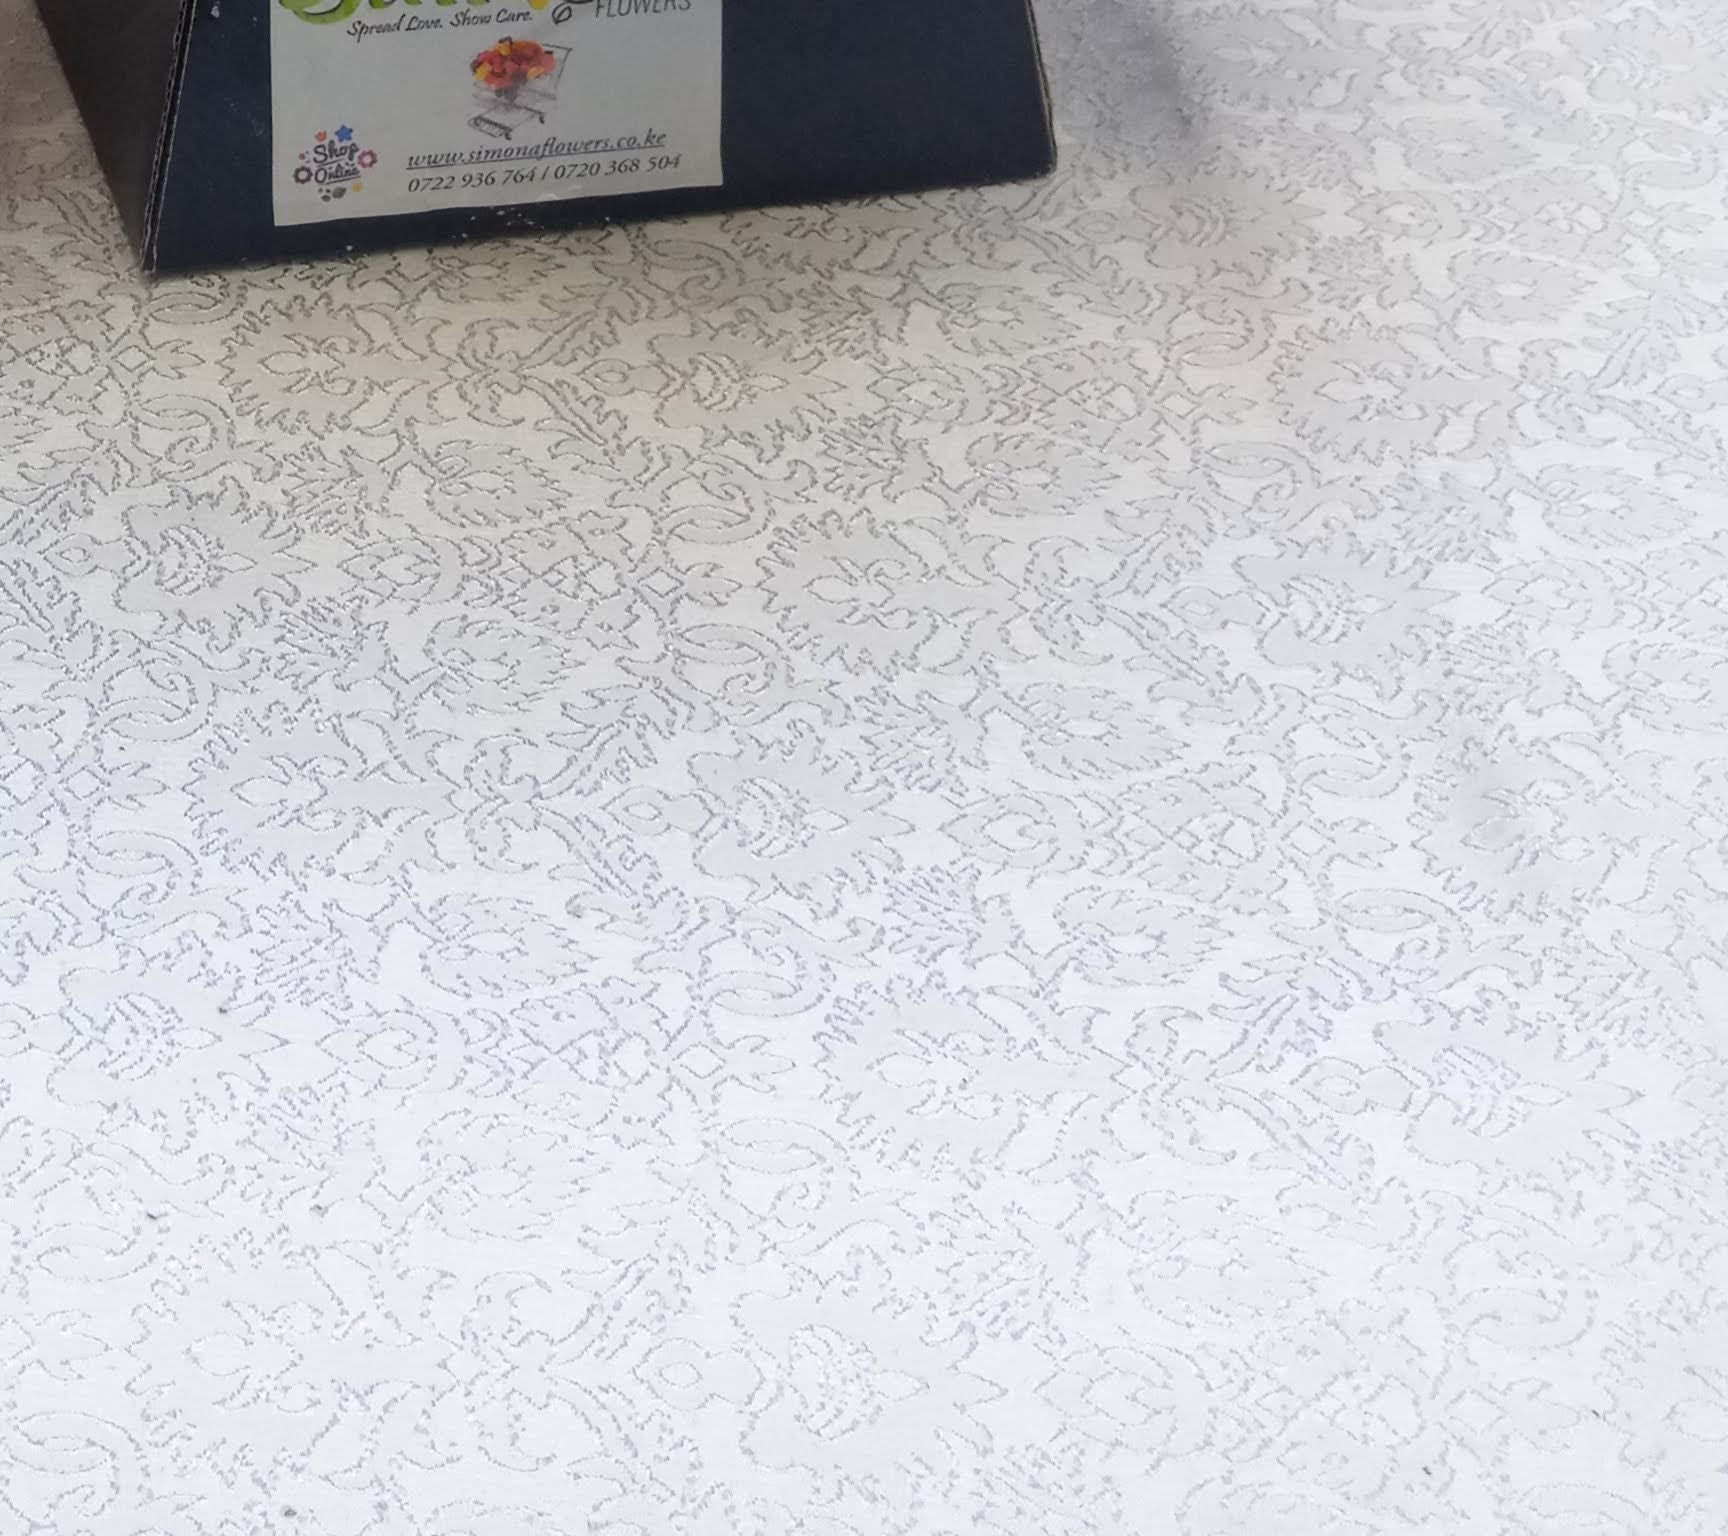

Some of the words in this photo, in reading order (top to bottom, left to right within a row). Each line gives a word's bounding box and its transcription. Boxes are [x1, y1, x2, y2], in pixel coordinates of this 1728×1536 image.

[346, 14, 405, 43] Spread
[450, 11, 492, 28] Show
[313, 140, 359, 164] Shop
[407, 128, 667, 168] www.simonaflowers.co.ke
[408, 176, 456, 193] 0722
[502, 167, 537, 185] 764
[554, 162, 601, 179] 0720
[604, 159, 640, 176] 368
[647, 153, 682, 170] 504
